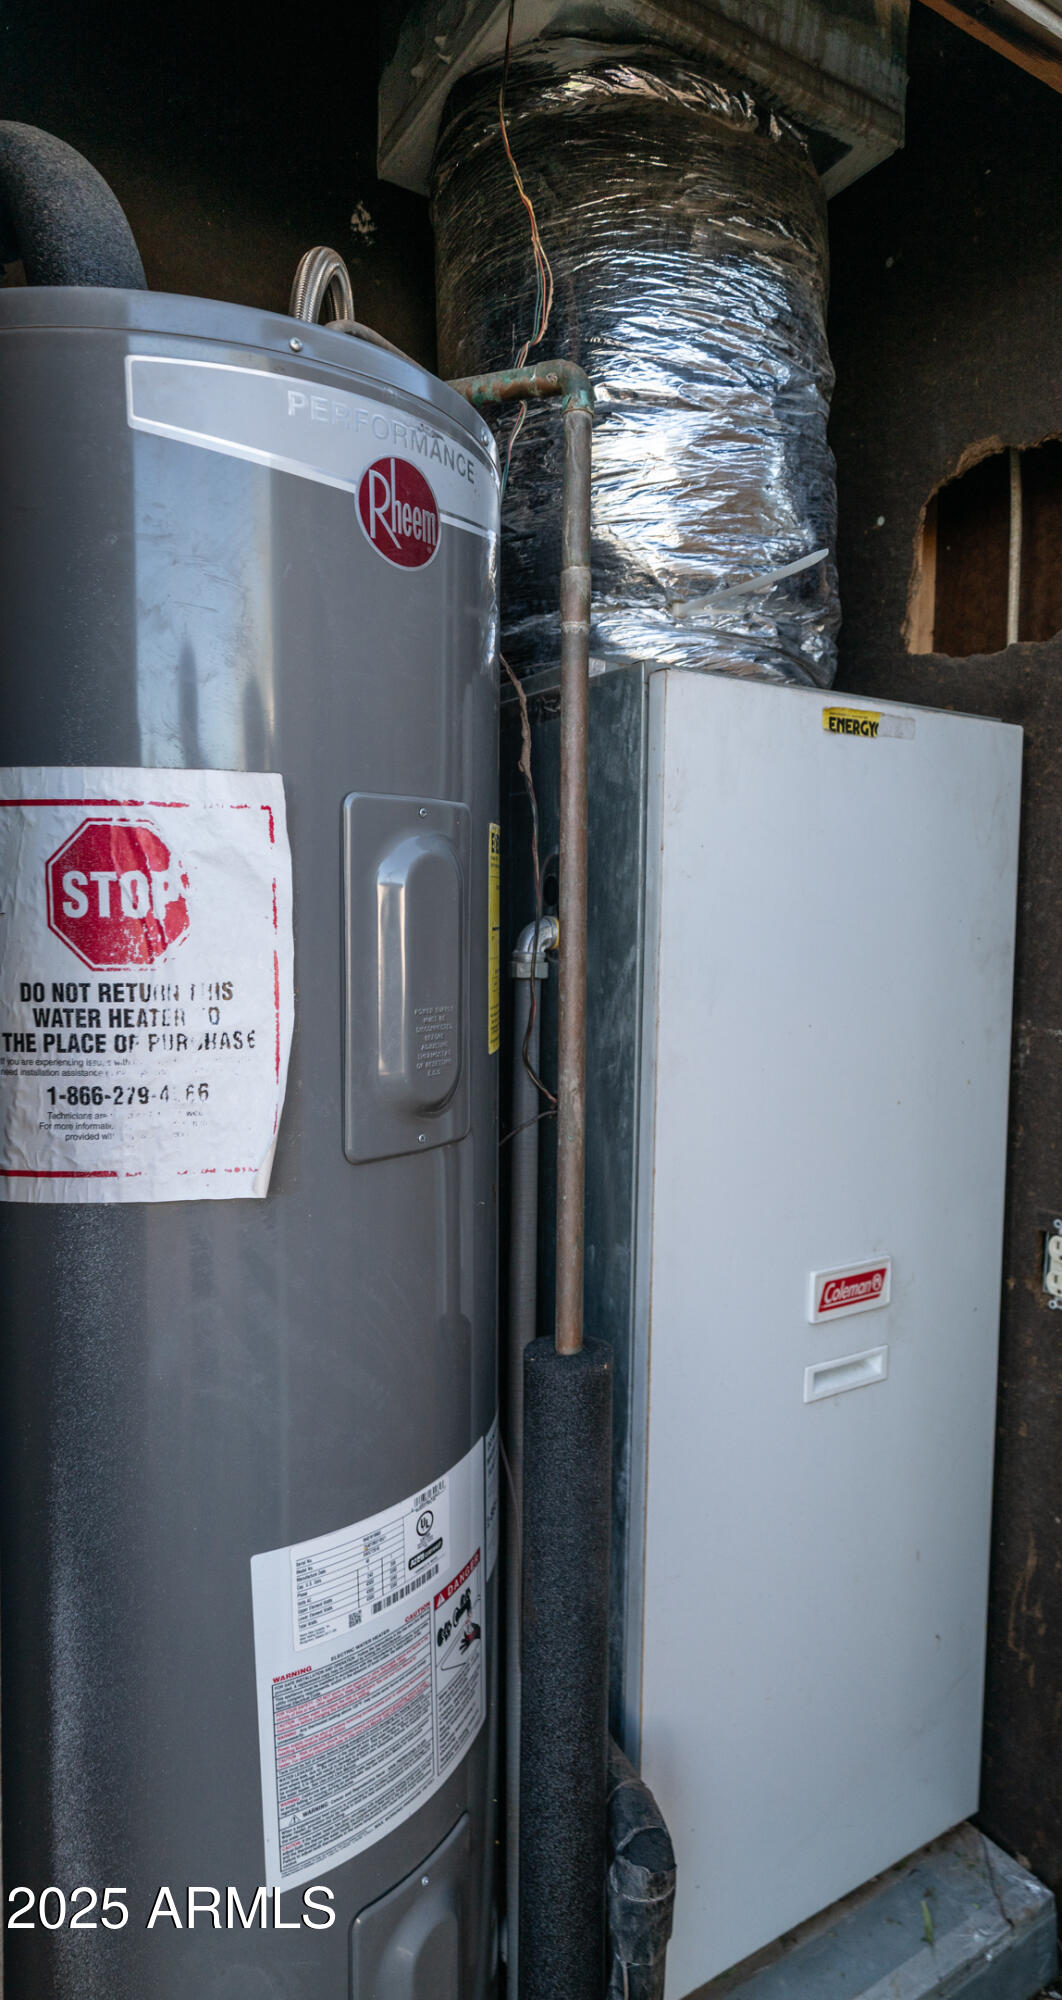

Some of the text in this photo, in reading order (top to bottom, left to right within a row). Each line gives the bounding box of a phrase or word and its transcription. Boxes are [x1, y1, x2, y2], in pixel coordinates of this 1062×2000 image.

[287, 390, 476, 484] PERFORMANCE
[368, 458, 438, 550] Rheem
[62, 870, 183, 919] STOP
[20, 982, 45, 1003] DO
[52, 982, 91, 1003] NOT
[190, 981, 234, 1001] TIS
[32, 1008, 101, 1028] WATER
[2, 1032, 37, 1053] THE
[43, 1033, 107, 1053] PLACE
[148, 1029, 256, 1053] PURHASE
[47, 1082, 209, 1106] 1-866-279-466
[823, 1278, 872, 1304] Coleman
[404, 1601, 431, 1624] CAUTION
[272, 1665, 313, 1684] WARNING
